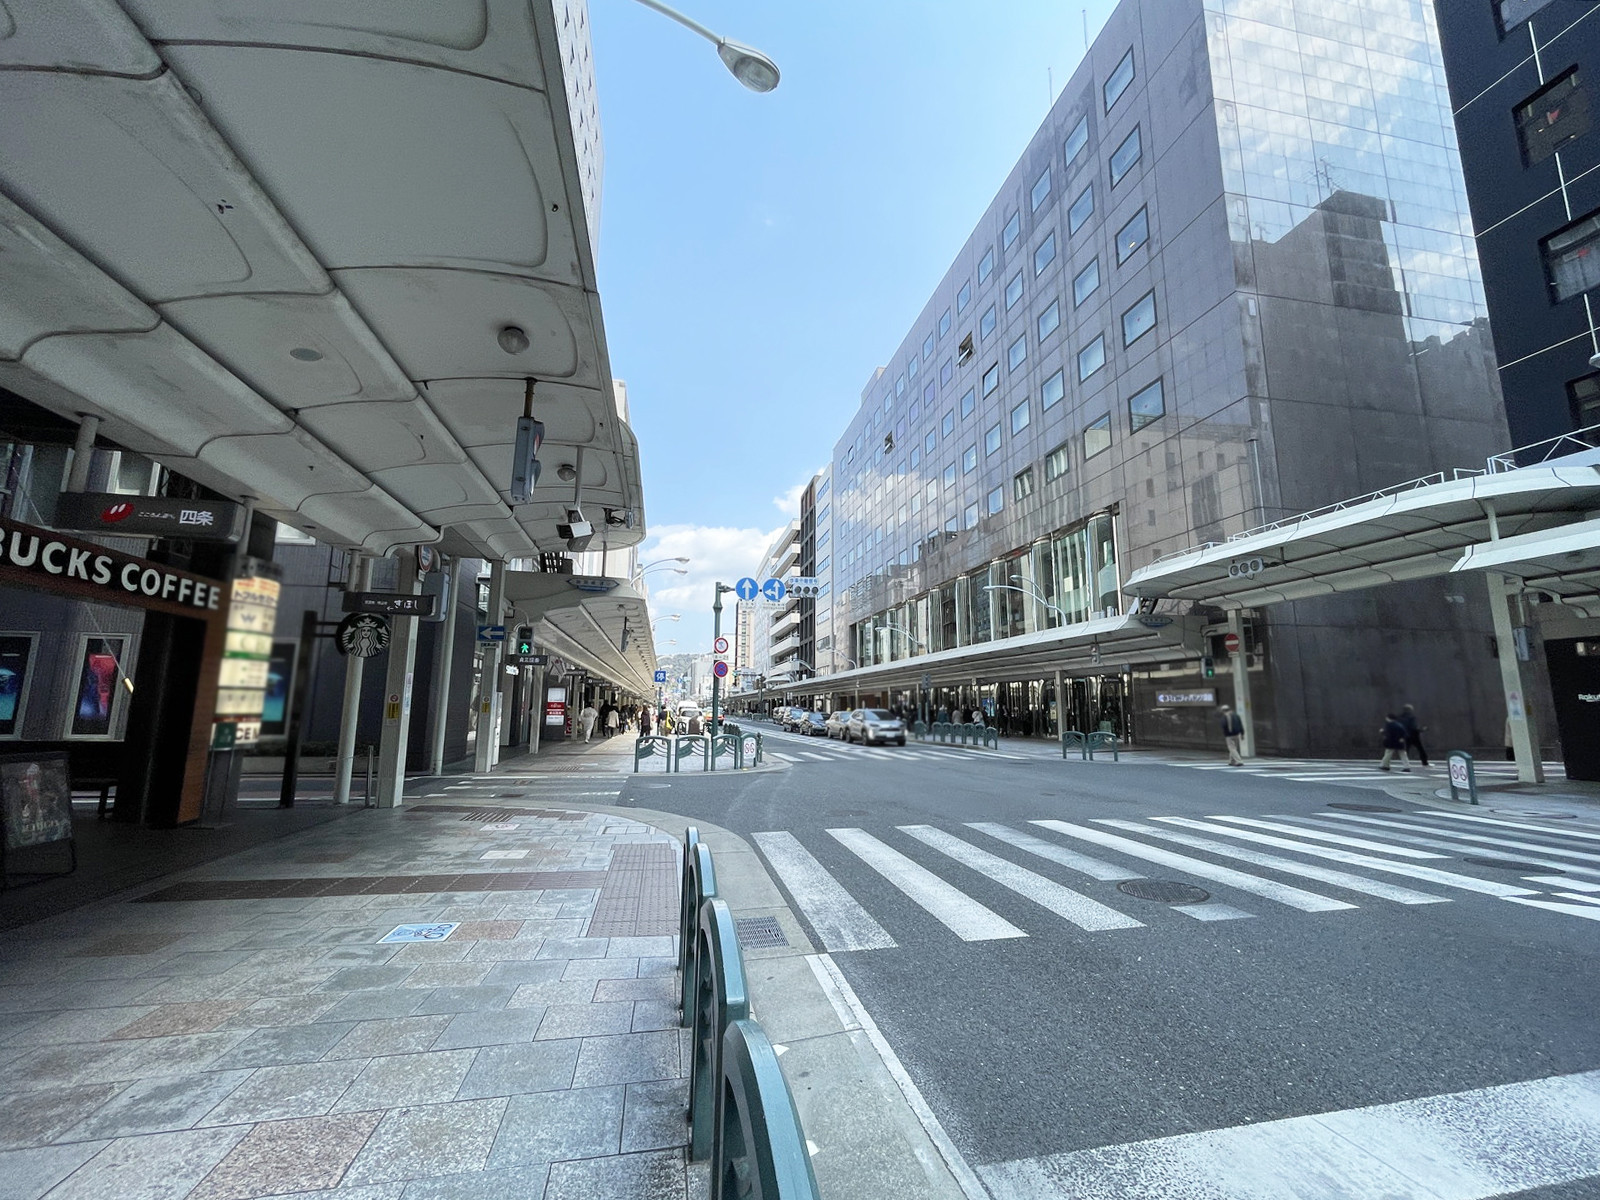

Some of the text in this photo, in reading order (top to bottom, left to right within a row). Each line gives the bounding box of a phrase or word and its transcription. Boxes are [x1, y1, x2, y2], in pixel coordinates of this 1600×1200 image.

[179, 509, 214, 526] 四条
[0, 527, 220, 609] UCKS COFFEE
